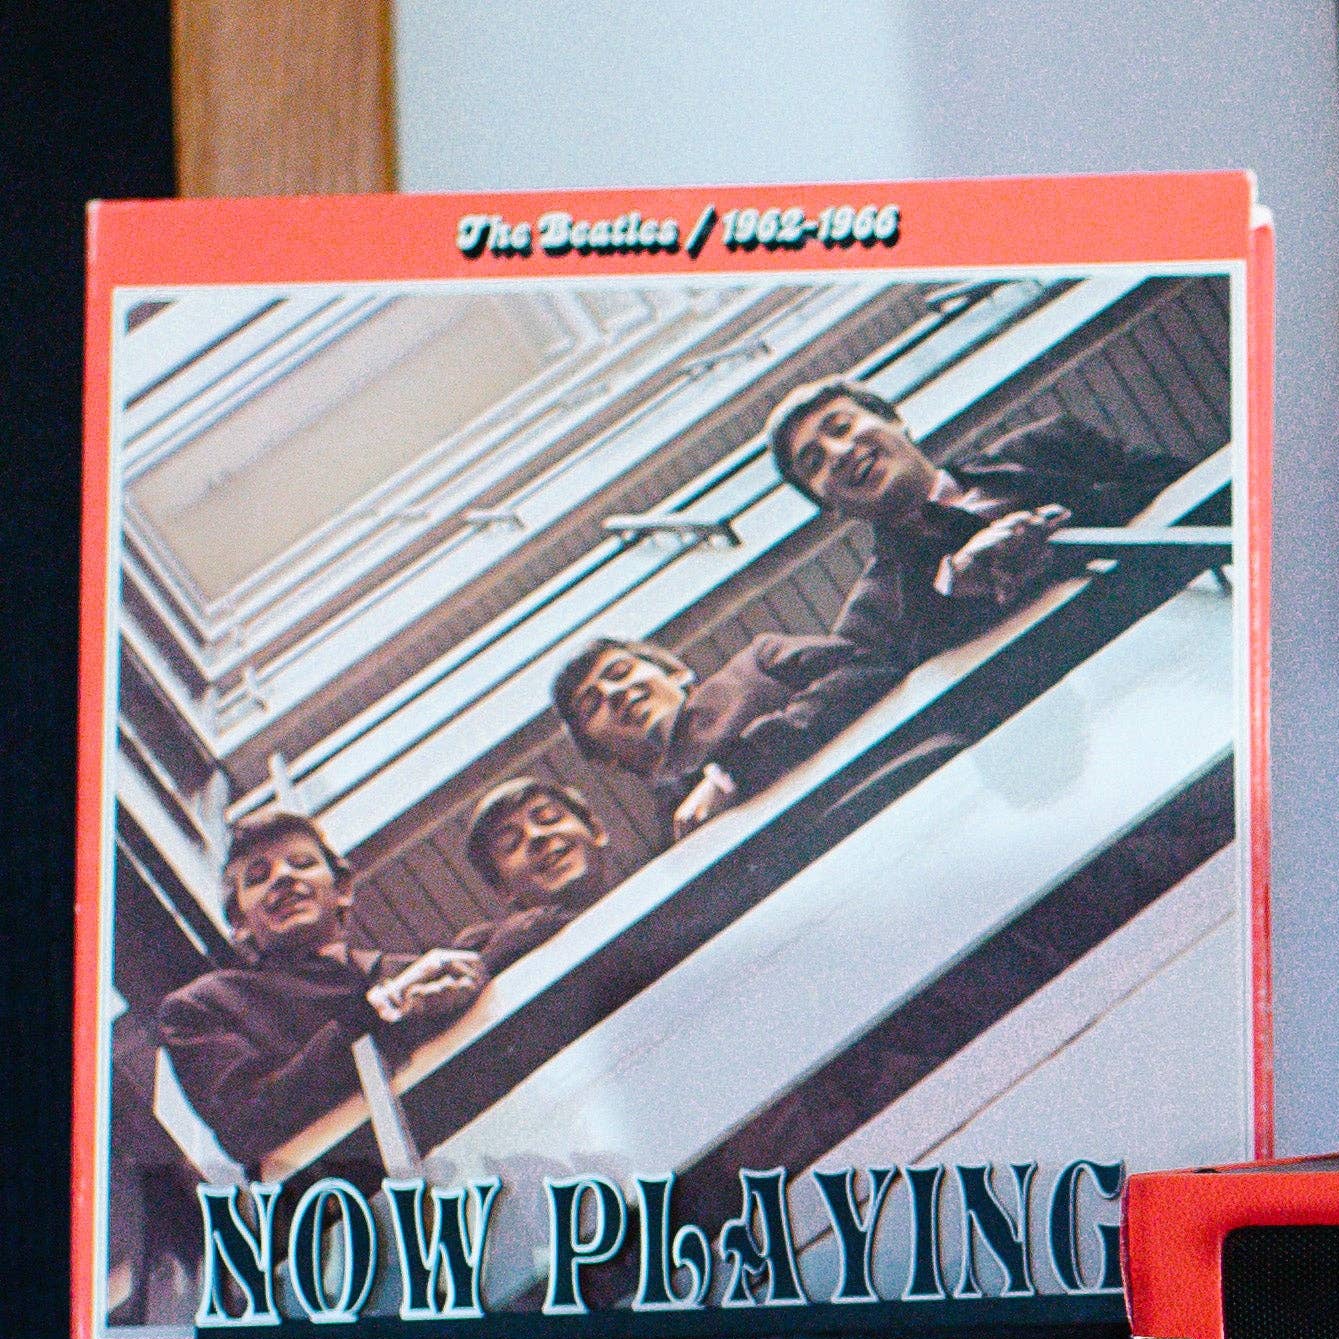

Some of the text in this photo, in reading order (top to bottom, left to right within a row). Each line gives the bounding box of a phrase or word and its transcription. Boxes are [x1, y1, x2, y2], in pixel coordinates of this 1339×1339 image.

[456, 212, 531, 259] The
[538, 209, 680, 255] Beatles
[722, 204, 900, 251] 1962-1966
[197, 1158, 1129, 1326] NOW PLAYING
